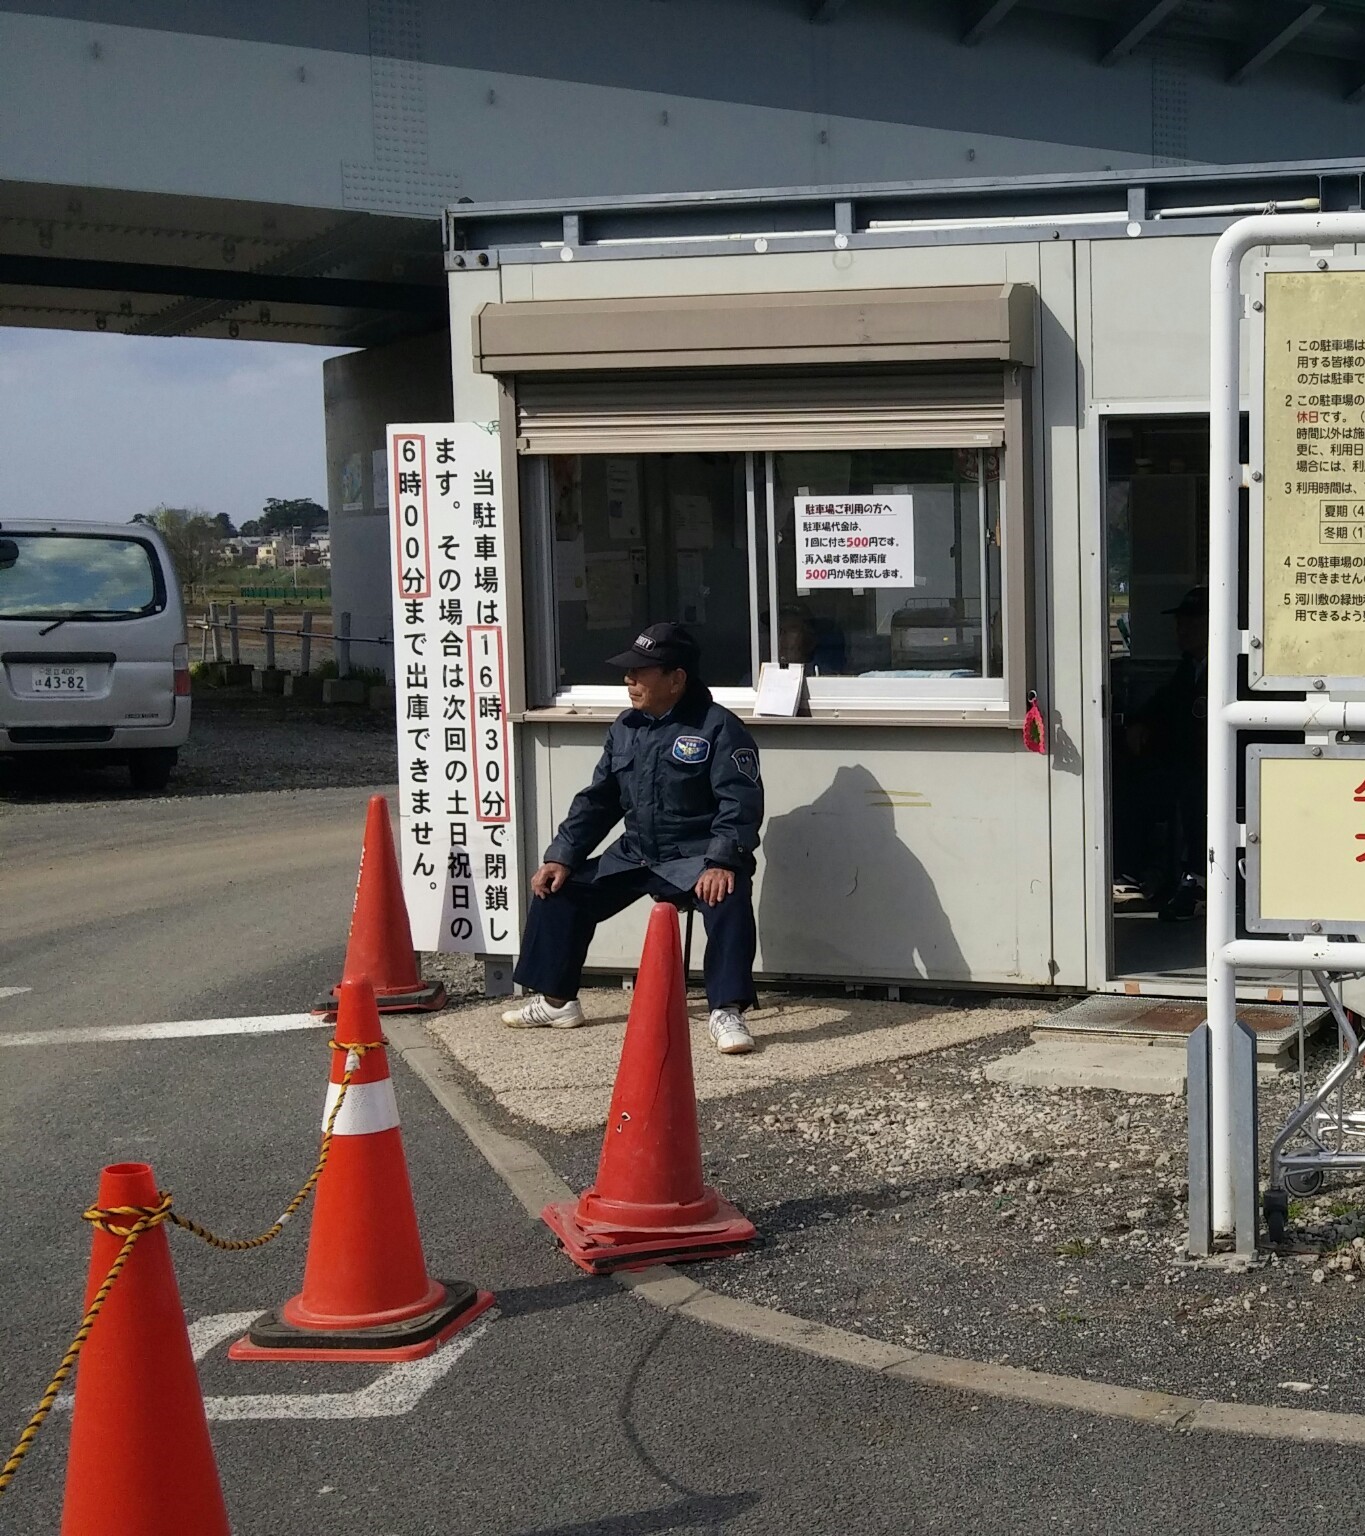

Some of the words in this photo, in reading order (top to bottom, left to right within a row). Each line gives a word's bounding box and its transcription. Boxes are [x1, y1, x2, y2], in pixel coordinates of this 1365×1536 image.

[1286, 341, 1291, 352] 1
[1285, 395, 1291, 407] 2
[1285, 483, 1291, 494] 3
[806, 503, 892, 514] 駐車場ご利用の方へ
[803, 522, 862, 532] 駐車場代金は、
[805, 537, 899, 547] 1回に付き500円です。
[1284, 556, 1290, 568] 4
[806, 569, 902, 580] 500円が発生致します。
[1284, 593, 1290, 605] 5
[45, 677, 84, 688] 43-82
[435, 438, 473, 940] ます。その場合は次回の土日祝日の
